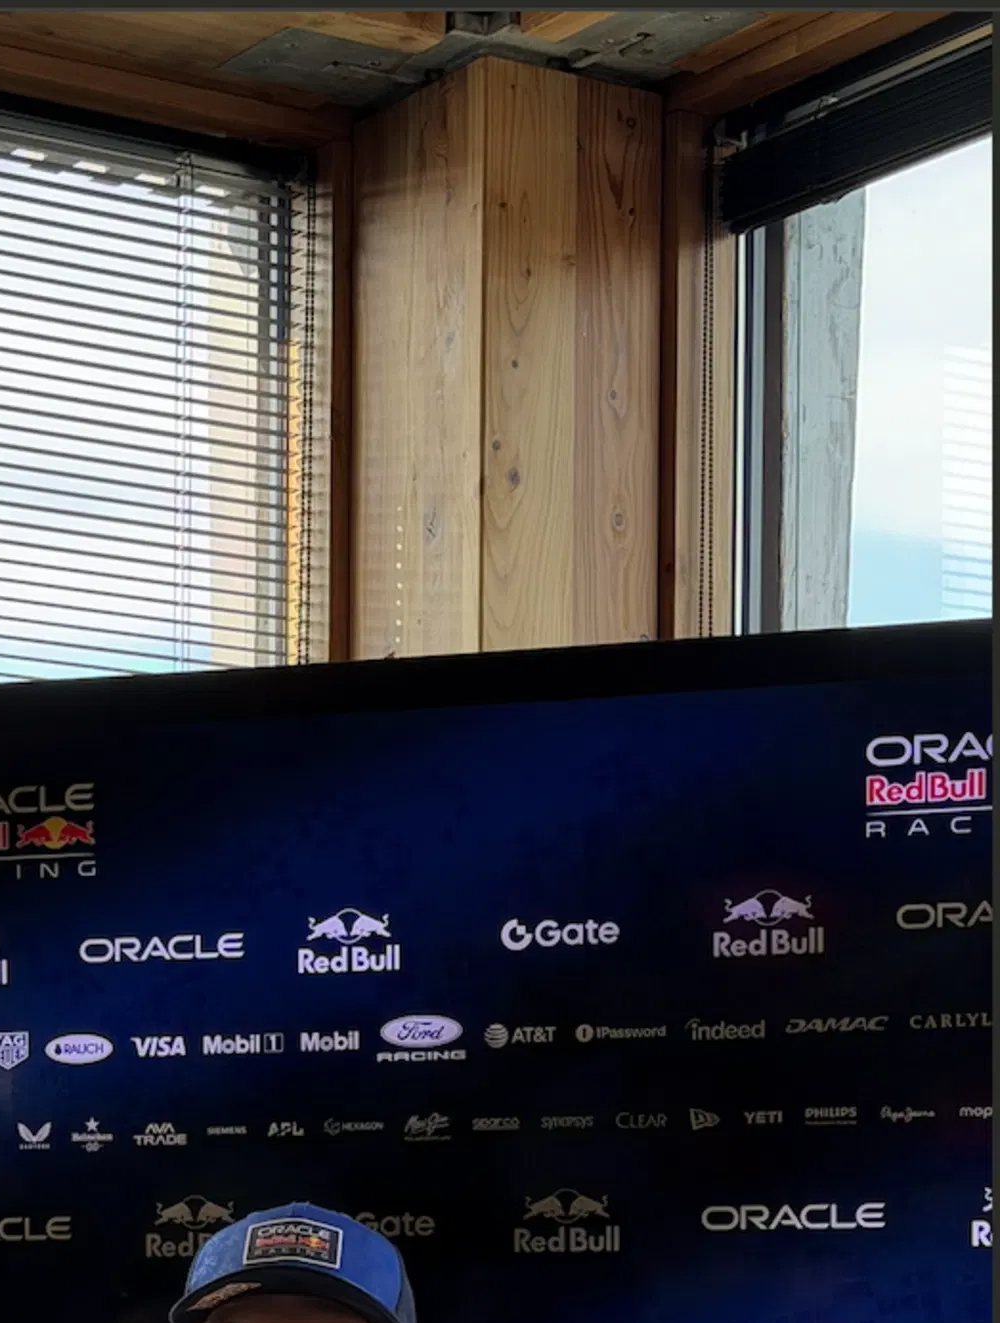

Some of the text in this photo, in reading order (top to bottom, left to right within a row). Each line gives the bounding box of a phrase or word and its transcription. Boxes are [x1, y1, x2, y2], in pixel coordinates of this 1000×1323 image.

[866, 731, 993, 767] ORA
[866, 768, 986, 806] Red Bull
[534, 917, 620, 947] Gate
[713, 927, 825, 958] Red Bull
[79, 932, 245, 963] ORACLE
[298, 944, 400, 974] Red Bull
[396, 1021, 446, 1042] Ford
[689, 1018, 766, 1041] indeed
[785, 1014, 889, 1034] DAMAC
[202, 1034, 261, 1055] Mobil
[300, 1031, 361, 1052] Mobil
[511, 1026, 557, 1044] AT&T
[63, 1043, 105, 1055] RAUCH
[131, 1036, 186, 1057] VISA
[376, 1050, 467, 1063] RACING
[615, 1111, 669, 1129] CLEAR
[743, 1109, 784, 1125] YETI
[804, 1106, 858, 1119] PHILIPS
[145, 1122, 176, 1134] AVA
[133, 1134, 188, 1146] TRADE
[702, 1202, 886, 1231] ORACLE
[257, 1223, 331, 1240] ORACLE
[514, 1225, 620, 1253] Red Bull
[145, 1233, 195, 1258] Red
